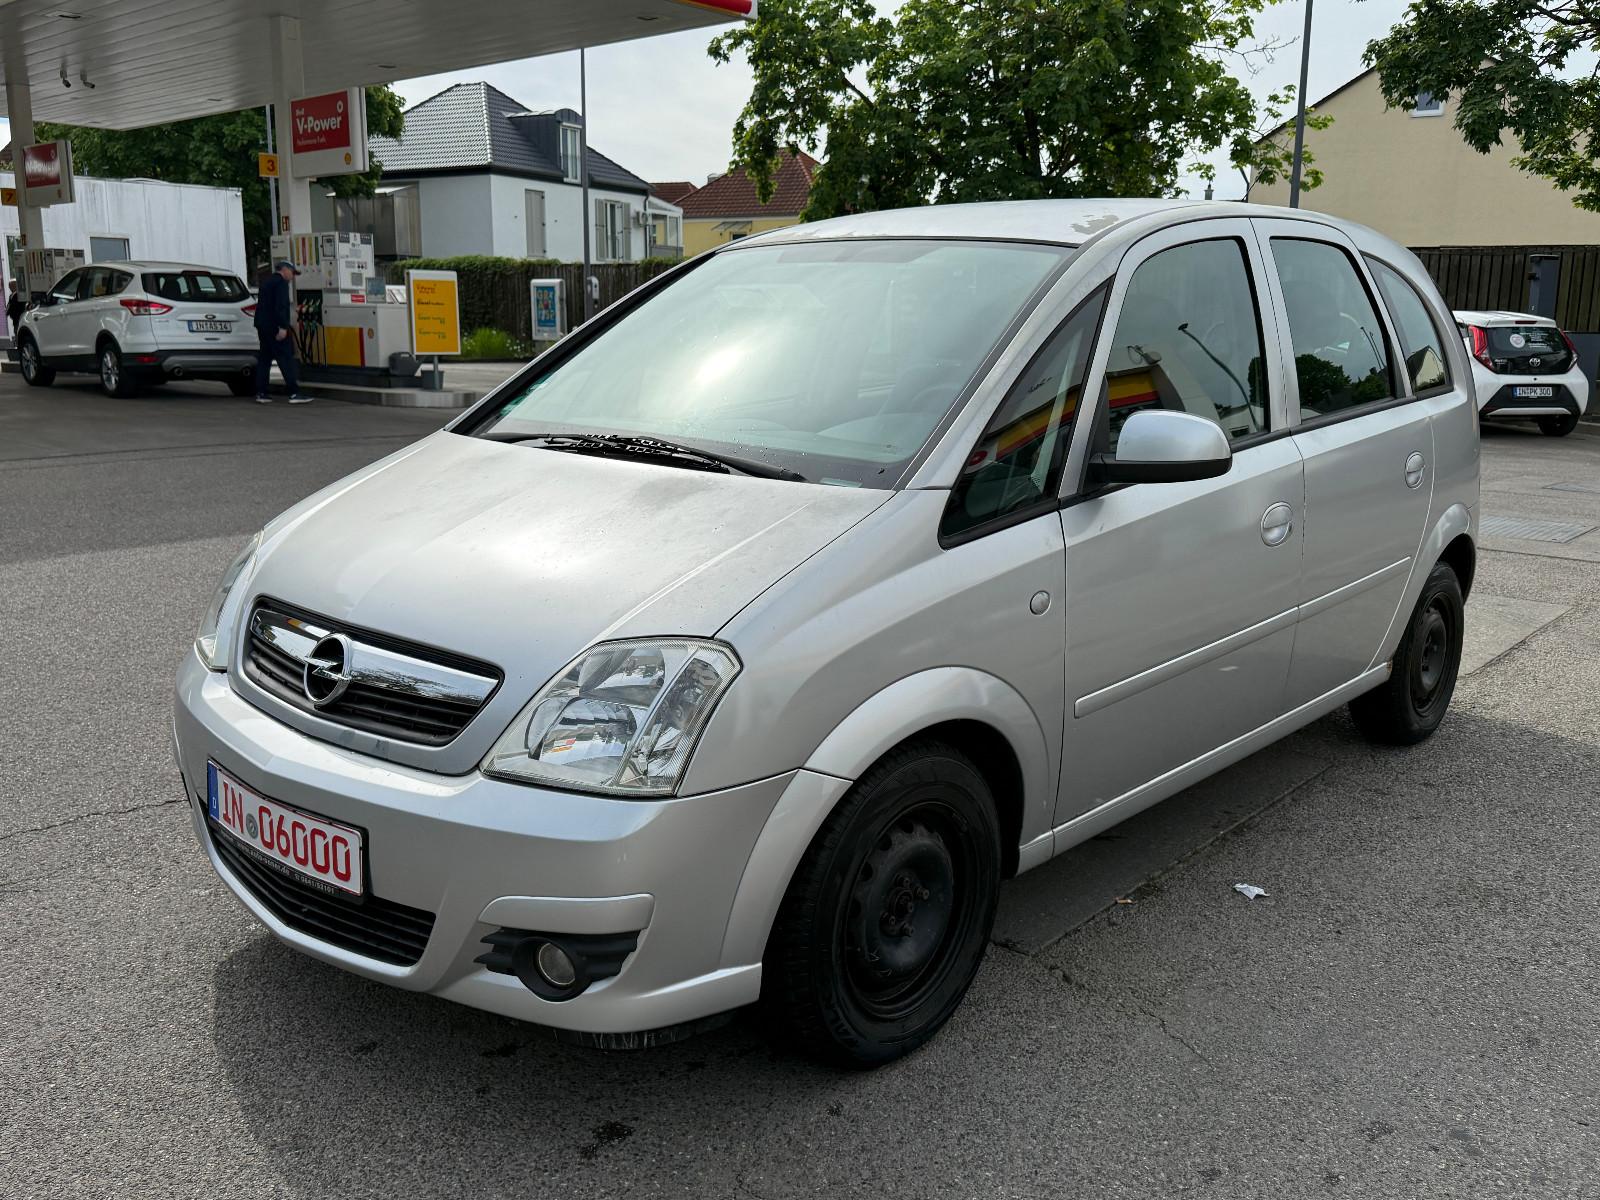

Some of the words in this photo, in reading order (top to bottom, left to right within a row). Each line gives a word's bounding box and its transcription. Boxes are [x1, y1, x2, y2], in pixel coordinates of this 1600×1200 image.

[296, 115, 342, 135] V-Power
[267, 159, 276, 172] 3
[6, 192, 13, 202] 7
[1518, 387, 1527, 395] IN
[1529, 387, 1538, 395] PK
[1539, 387, 1551, 395] 300
[212, 796, 217, 809] D
[222, 779, 244, 834] IN
[258, 805, 352, 883] 06000
